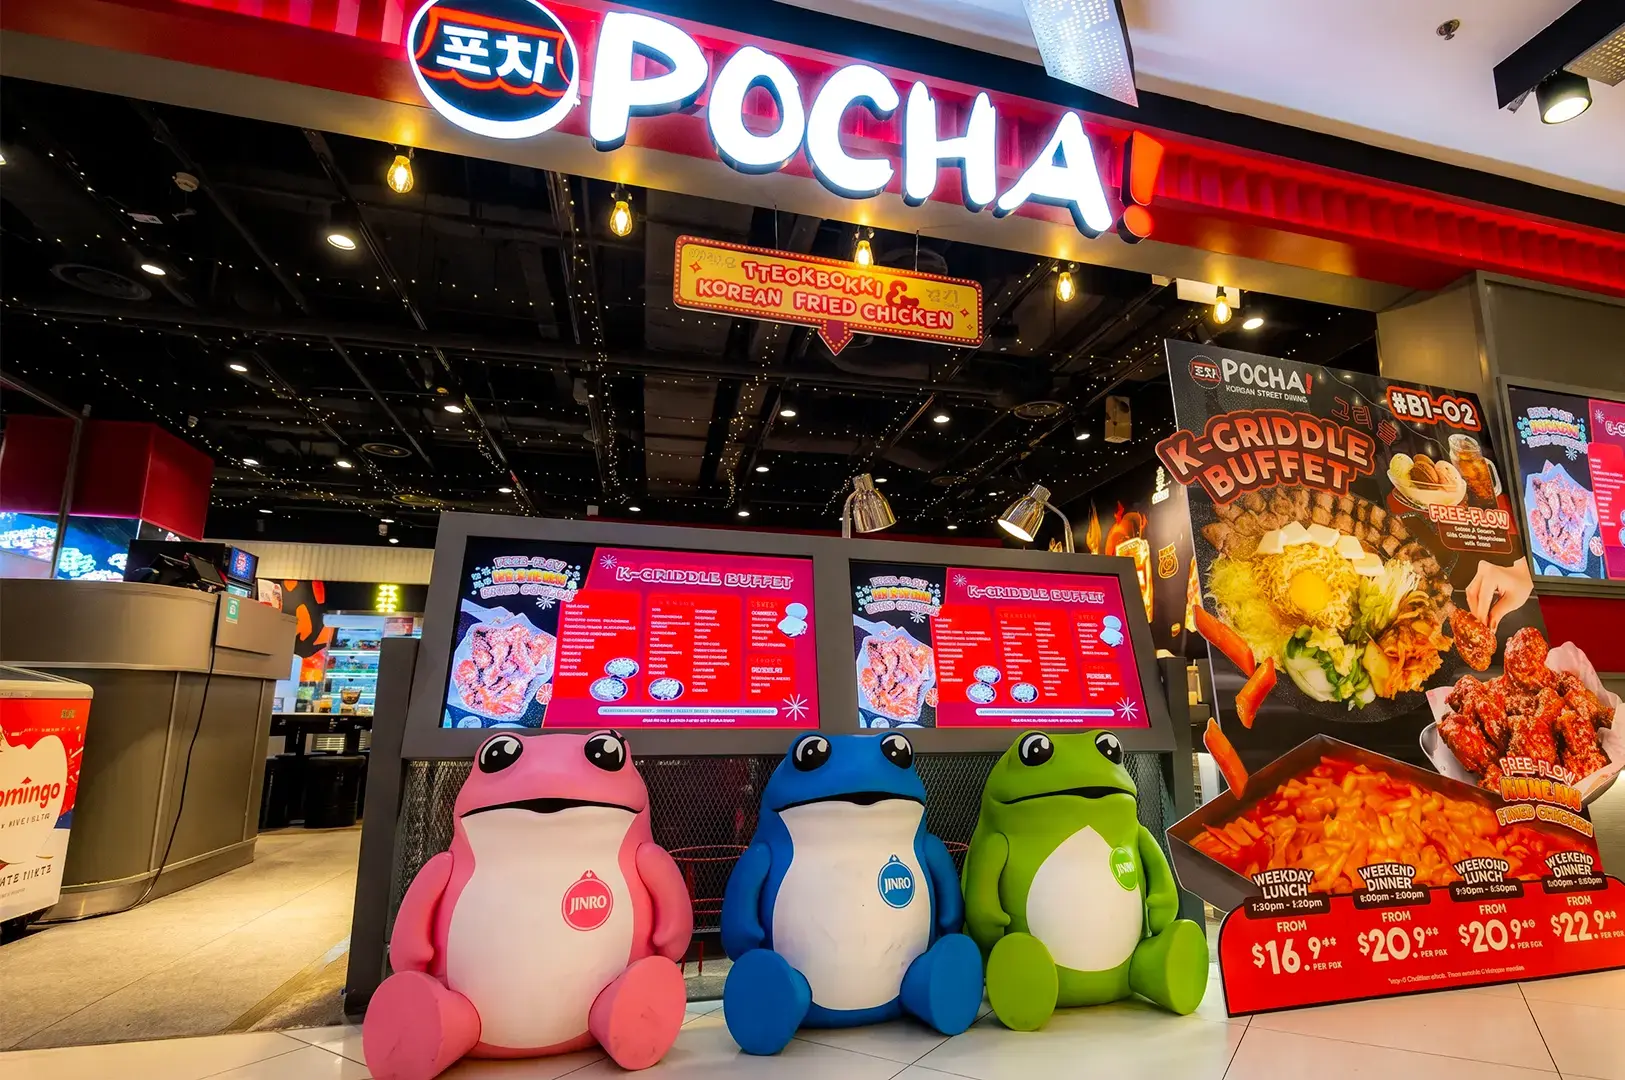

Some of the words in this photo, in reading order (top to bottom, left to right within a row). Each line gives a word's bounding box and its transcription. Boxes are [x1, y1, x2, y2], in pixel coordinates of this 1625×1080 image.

[436, 25, 554, 84] 포차
[743, 262, 884, 299] TTEOKBOKKI
[697, 279, 782, 306] KOREAN
[793, 291, 857, 317] FRIED
[862, 303, 954, 328] CHICKEN
[1221, 358, 1313, 395] POCHA!
[1257, 389, 1284, 400] STREET
[1165, 416, 1369, 477] K-GRIDDLE
[1203, 450, 1350, 498] BUFFET
[1430, 504, 1508, 528] FREE-FLOW
[724, 573, 793, 589] BUFFET
[1545, 852, 1594, 869] WEEKEND
[1253, 870, 1313, 886] WEEKDAY
[1359, 864, 1415, 880] WEEKEND
[1464, 870, 1503, 884] LUNCH
[1553, 864, 1592, 878] DINNER
[884, 877, 911, 894] JINRO
[1263, 884, 1307, 899] LUNCH
[1366, 877, 1412, 892] DINNER
[569, 894, 607, 915] JINRO
[1566, 895, 1592, 906] FROM
[1381, 911, 1411, 922] FROM
[1479, 903, 1507, 915] FROM
[1276, 920, 1307, 932] FROM
